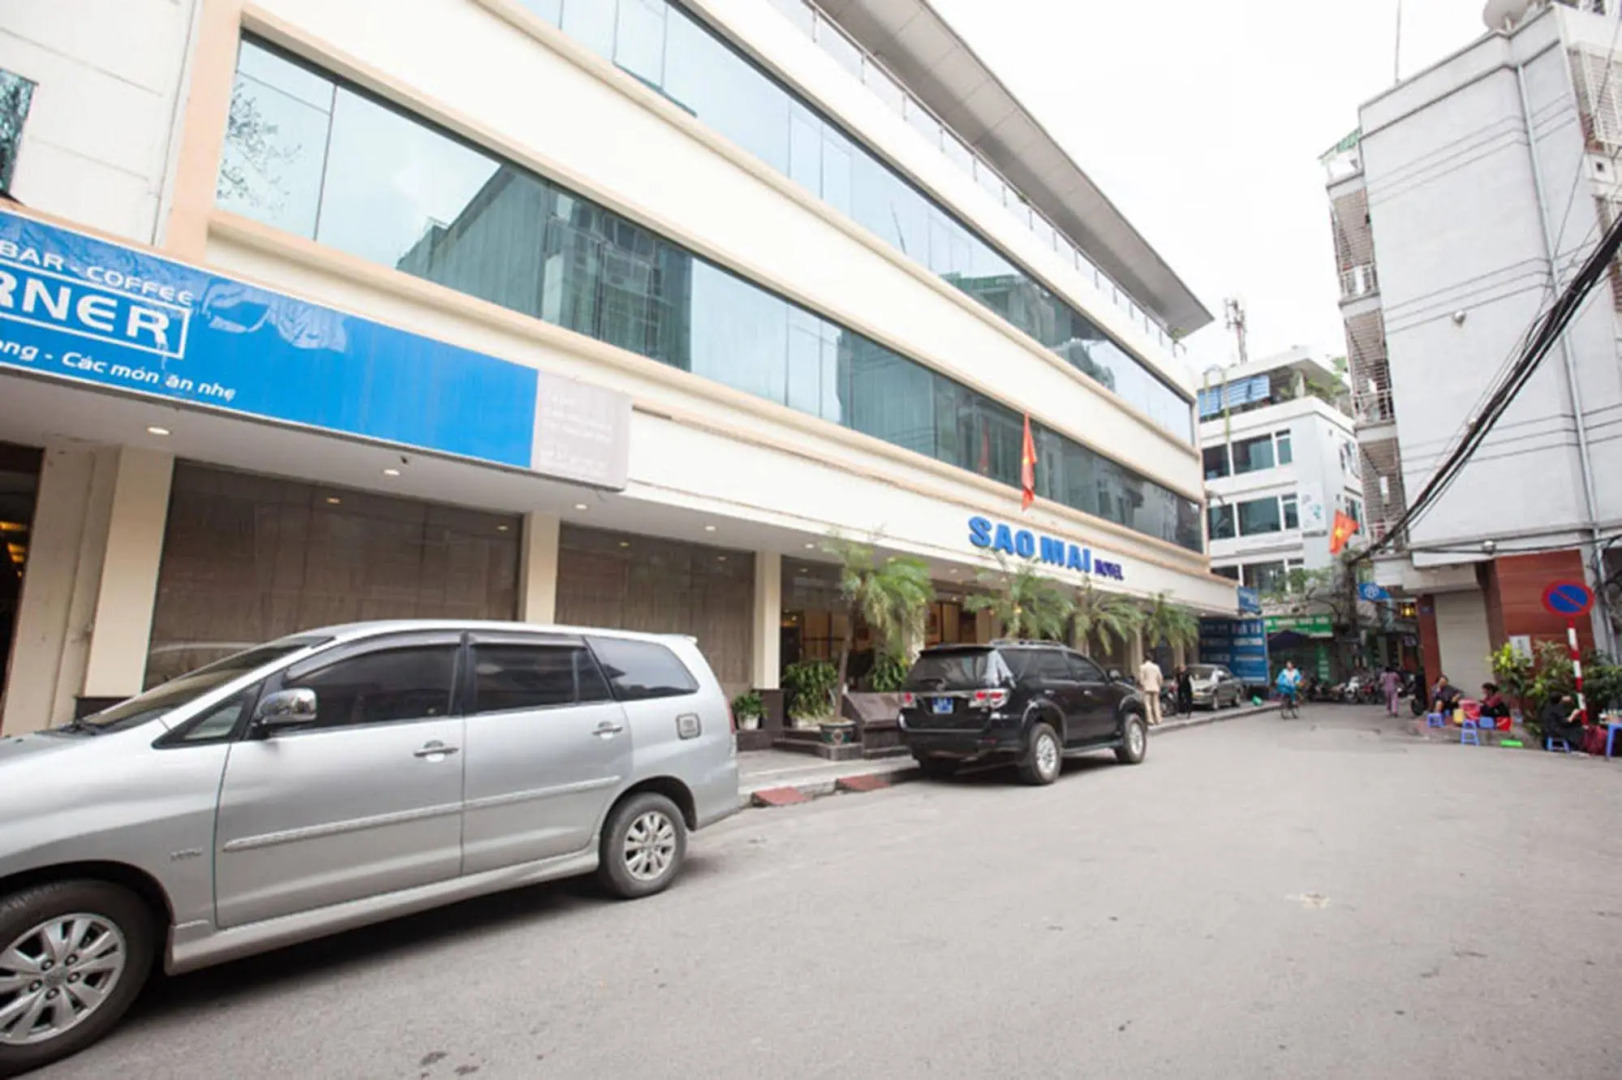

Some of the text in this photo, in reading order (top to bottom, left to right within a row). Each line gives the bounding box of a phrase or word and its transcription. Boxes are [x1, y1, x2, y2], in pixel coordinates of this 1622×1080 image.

[0, 240, 63, 271] BAR
[86, 266, 194, 307] COFFEE
[62, 351, 107, 374] Các
[110, 364, 159, 384] món
[968, 516, 1035, 558] SAO
[1040, 535, 1091, 573] MAI
